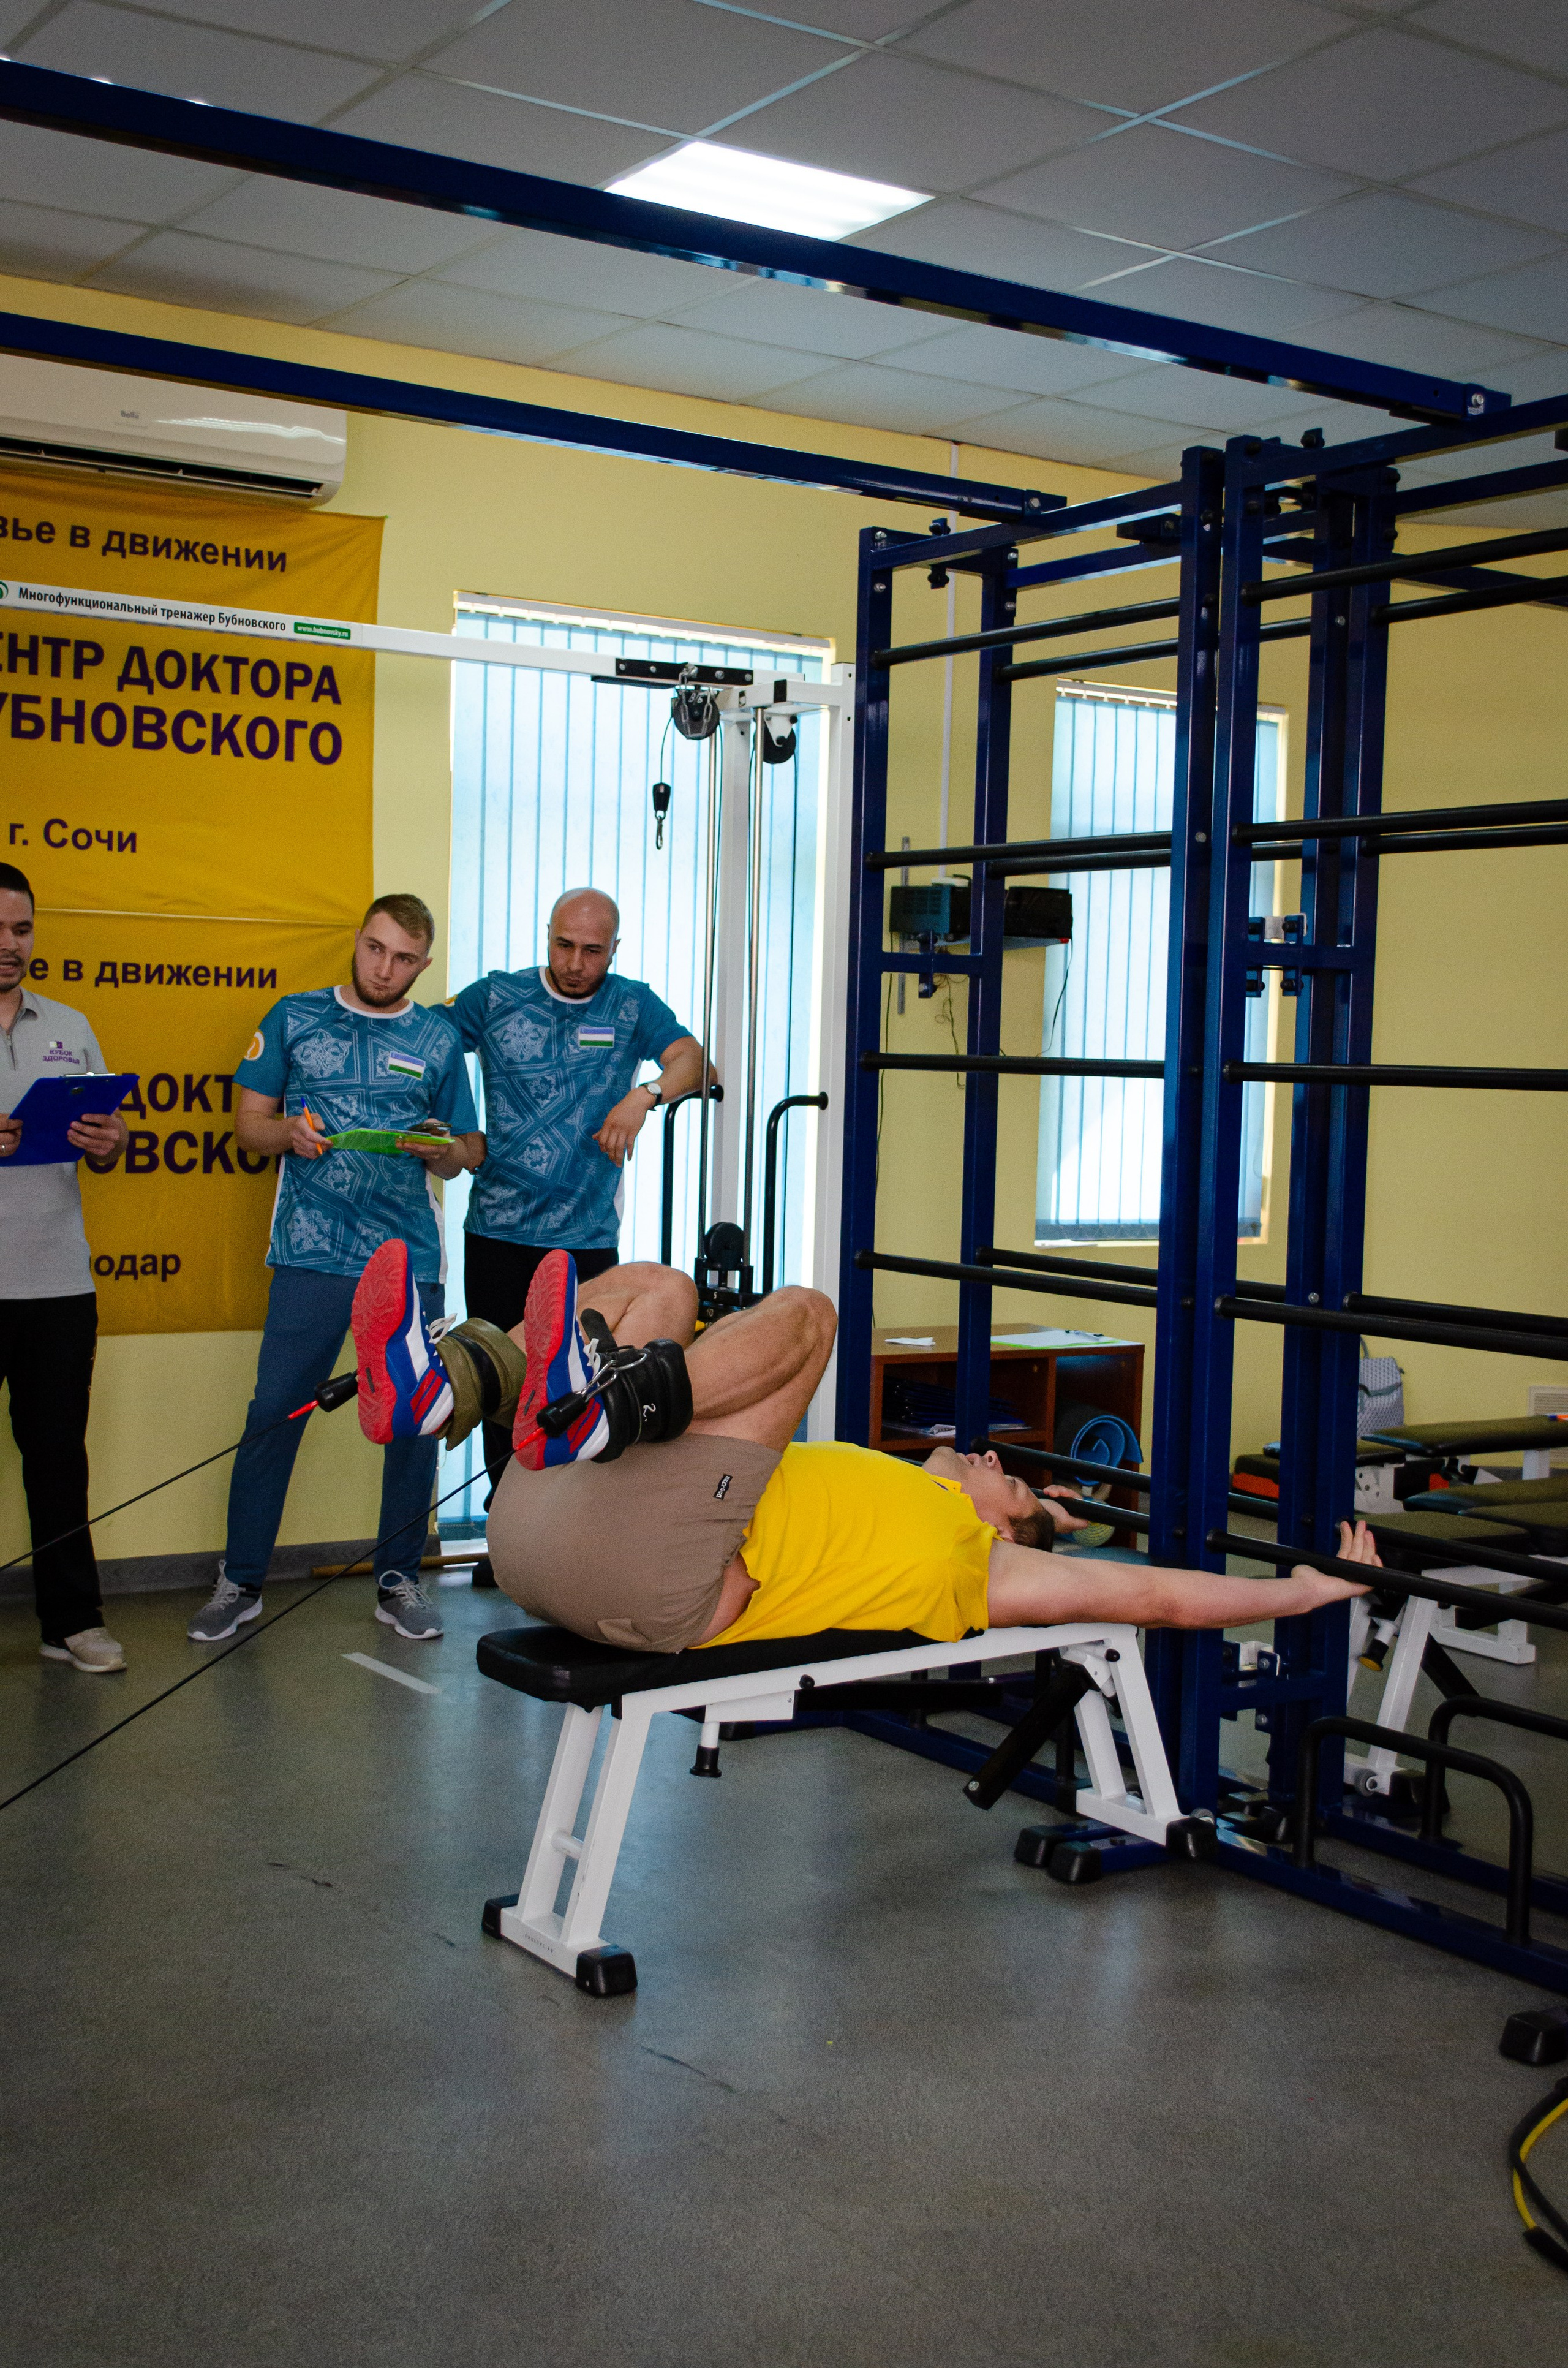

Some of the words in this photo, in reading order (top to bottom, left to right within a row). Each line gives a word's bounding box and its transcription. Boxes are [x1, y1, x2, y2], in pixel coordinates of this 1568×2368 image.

[70, 524, 91, 548] в
[102, 529, 287, 572] движении
[18, 587, 158, 615] Многофункциональный
[161, 607, 215, 624] тренажер
[218, 612, 286, 631] Бубновского
[297, 625, 349, 638] www.bubnovsky.ru
[0, 632, 104, 679] НТР
[117, 646, 342, 705] ДОКТОРА
[9, 823, 28, 845] г.
[43, 818, 137, 853] Сочи
[28, 958, 49, 980] е
[63, 959, 83, 981] в
[94, 961, 277, 988] движении
[42, 1056, 80, 1064] ЗДОРОВЬЯ
[119, 1073, 235, 1119] ДОКТ
[92, 1254, 181, 1282] одар
